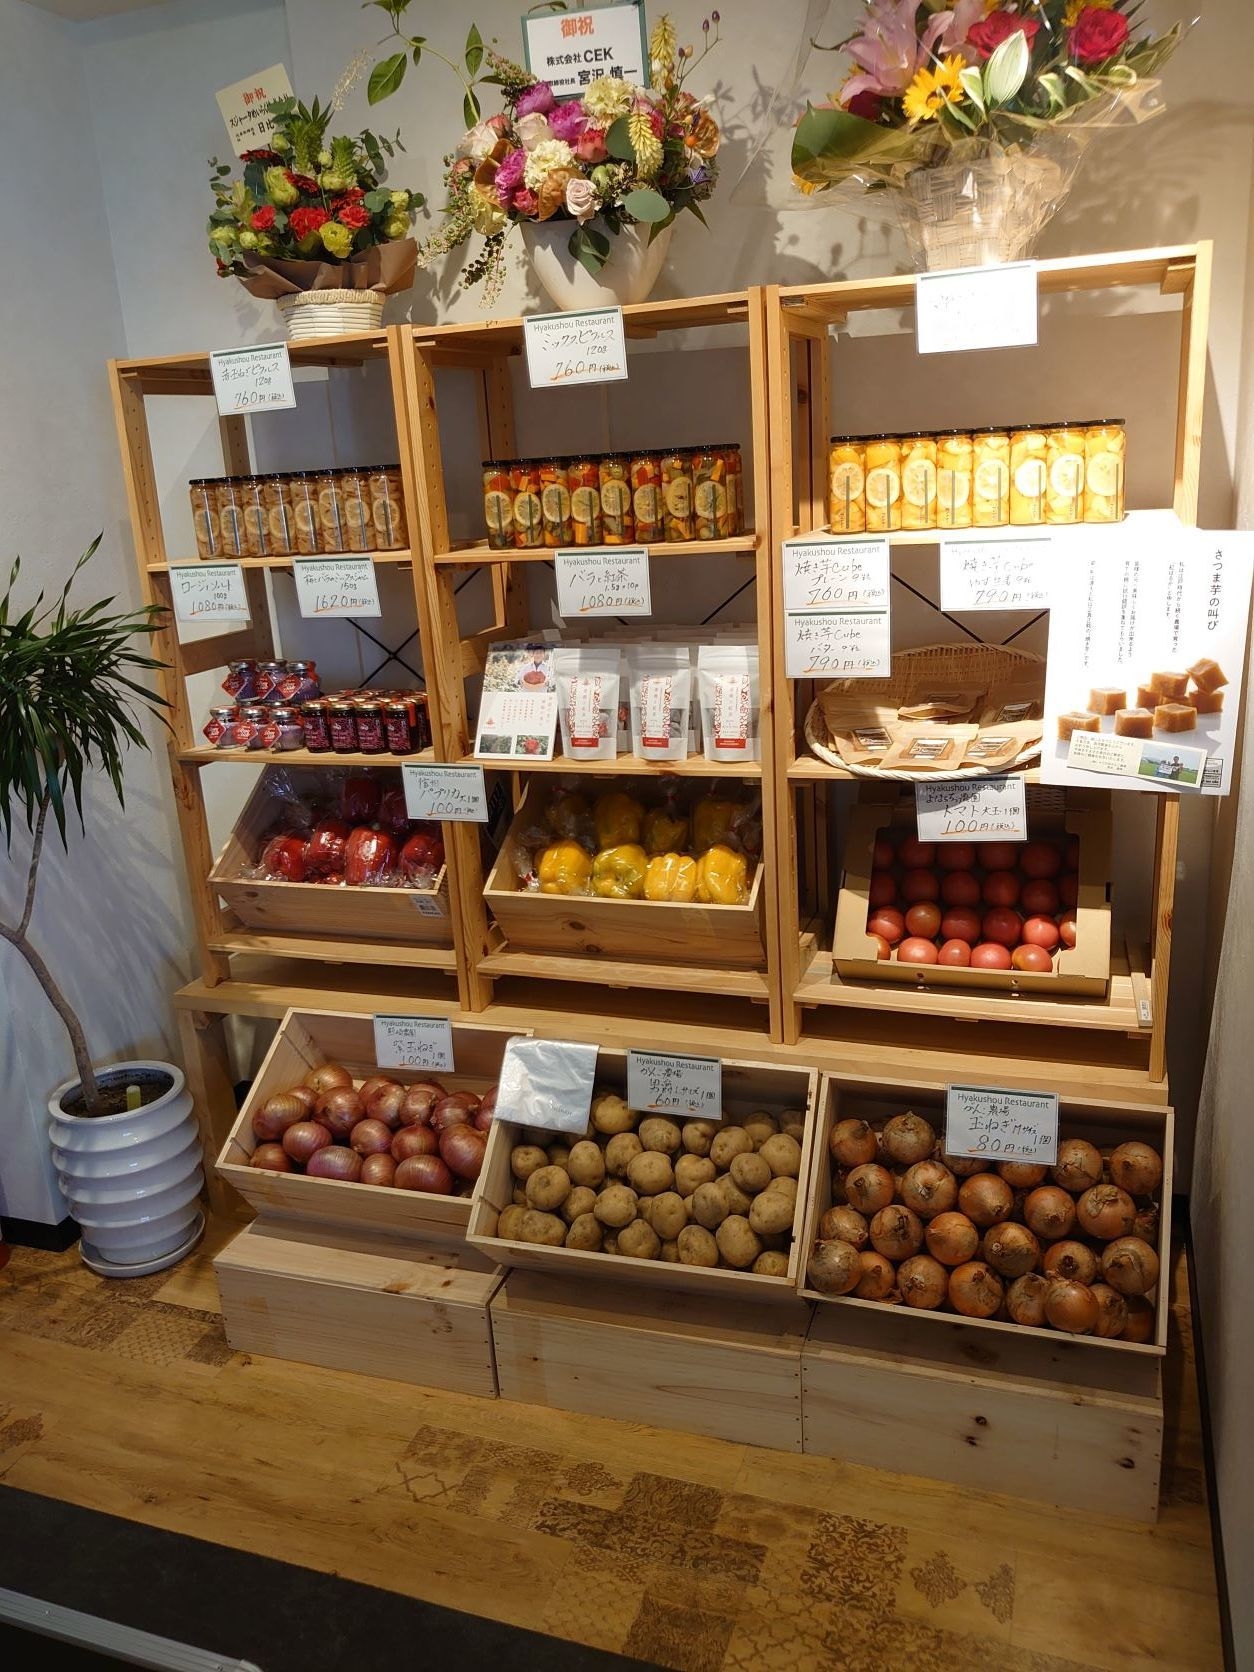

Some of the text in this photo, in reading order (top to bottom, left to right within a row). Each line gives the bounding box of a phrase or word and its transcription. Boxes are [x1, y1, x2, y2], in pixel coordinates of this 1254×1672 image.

[560, 16, 595, 39] 御祝
[243, 87, 267, 106] 御祝
[533, 316, 615, 333] Hyakushou Restaurant
[542, 330, 614, 351] ミックスピクルス
[586, 345, 608, 356] 120g
[218, 351, 283, 367] Hyakushou Restaurant
[792, 546, 881, 559] Hyakushou Restaurant
[301, 563, 368, 573] Hyakushou Restaurant
[563, 556, 640, 567] Hyakushou Restaurant
[176, 569, 236, 579] Hyakushou Restaurant
[1207, 549, 1223, 630] さつま芋の叫び
[794, 617, 882, 628] Hyakushou Restaurant
[810, 643, 835, 654] バター
[409, 769, 477, 778] Hyakushou Restaurant
[926, 783, 1016, 793] Hyakushou Restaurant
[945, 819, 1015, 833] 100円(税込)
[381, 1020, 445, 1029] Hyakushou Restaurant
[636, 1057, 715, 1072] Hyakushou Restaurant
[957, 1093, 1049, 1109] Hyakushou Restaurant
